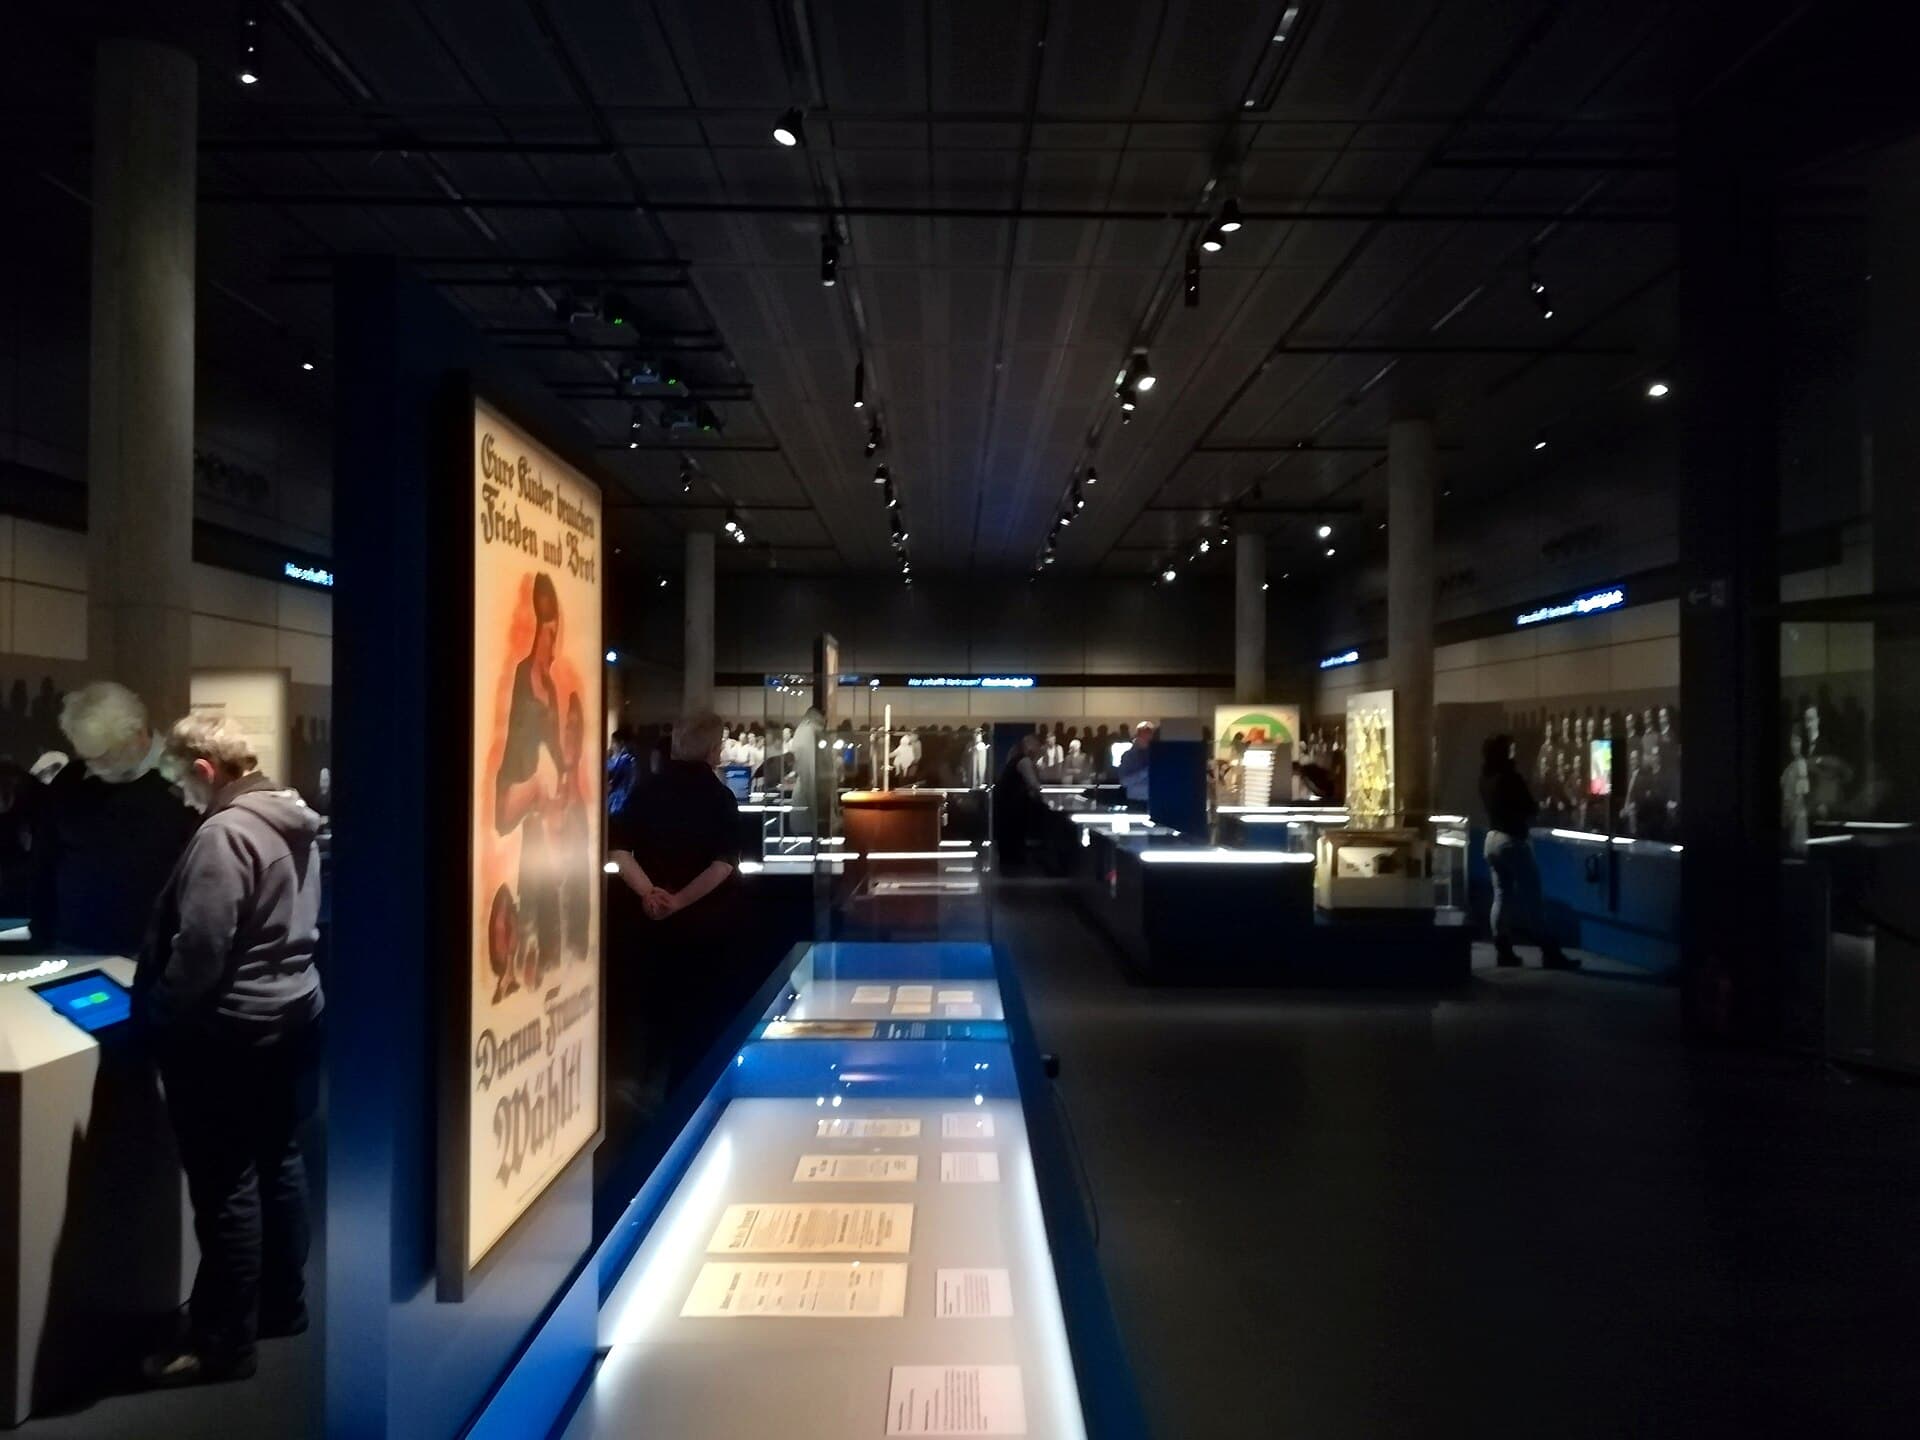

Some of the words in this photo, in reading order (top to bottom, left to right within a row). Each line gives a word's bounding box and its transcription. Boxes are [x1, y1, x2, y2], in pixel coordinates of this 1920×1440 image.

[517, 456, 554, 514] Kinder
[480, 483, 538, 556] Frieden
[543, 531, 563, 568] und
[475, 1017, 542, 1091] Darum
